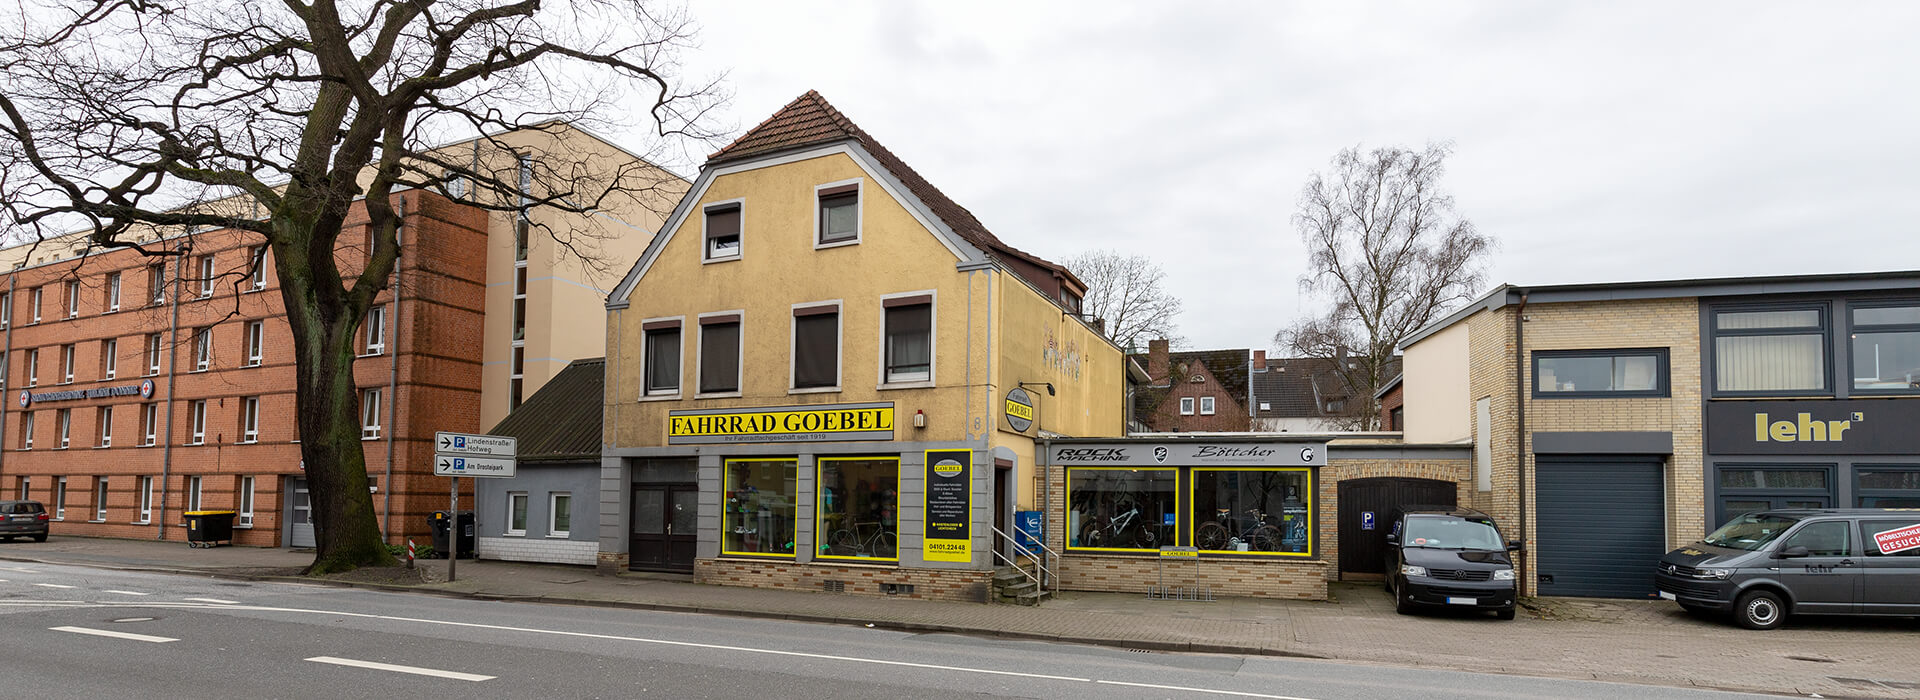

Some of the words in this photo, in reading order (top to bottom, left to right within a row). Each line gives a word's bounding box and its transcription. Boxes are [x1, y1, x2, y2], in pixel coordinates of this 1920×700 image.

[1008, 402, 1031, 418] GOEBEL
[671, 415, 776, 434] FAHRRAD
[783, 411, 891, 431] GOEBEL
[974, 417, 981, 430] 8
[1755, 413, 1851, 442] lehr
[467, 445, 492, 454] Hofweg
[1056, 448, 1127, 456] ROCK
[1192, 445, 1276, 458] Böttcher
[1364, 513, 1372, 523] P
